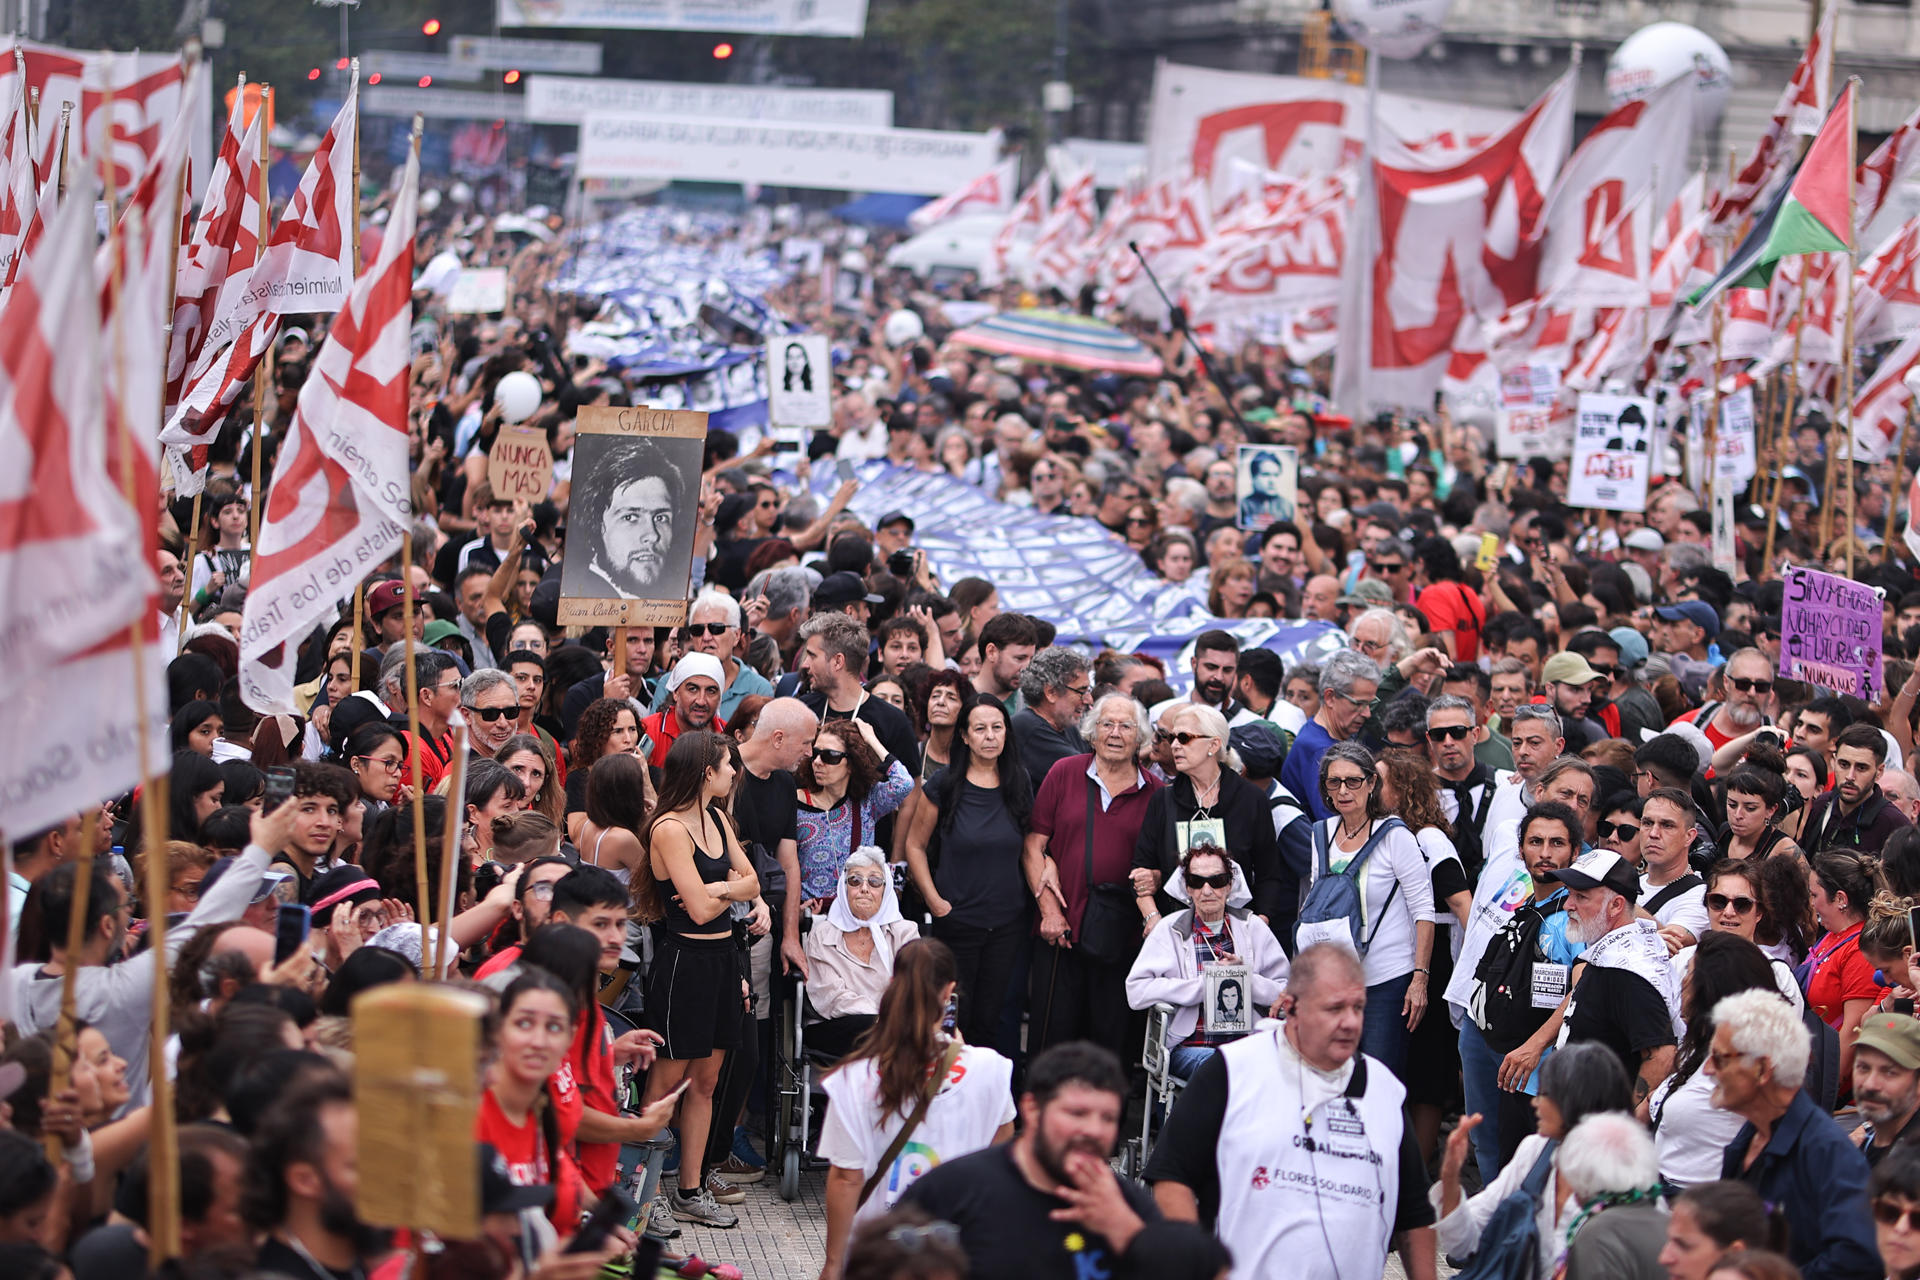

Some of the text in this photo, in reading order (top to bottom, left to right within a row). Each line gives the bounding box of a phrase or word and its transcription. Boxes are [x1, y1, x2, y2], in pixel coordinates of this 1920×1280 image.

[618, 409, 675, 432] GARCIA
[496, 443, 547, 469] NUNCA
[502, 470, 541, 496] MAS
[1803, 666, 1857, 695] NUNCA MAS
[1274, 1168, 1317, 1186] FLORES
[1318, 1178, 1372, 1200] SOLIDARIO
